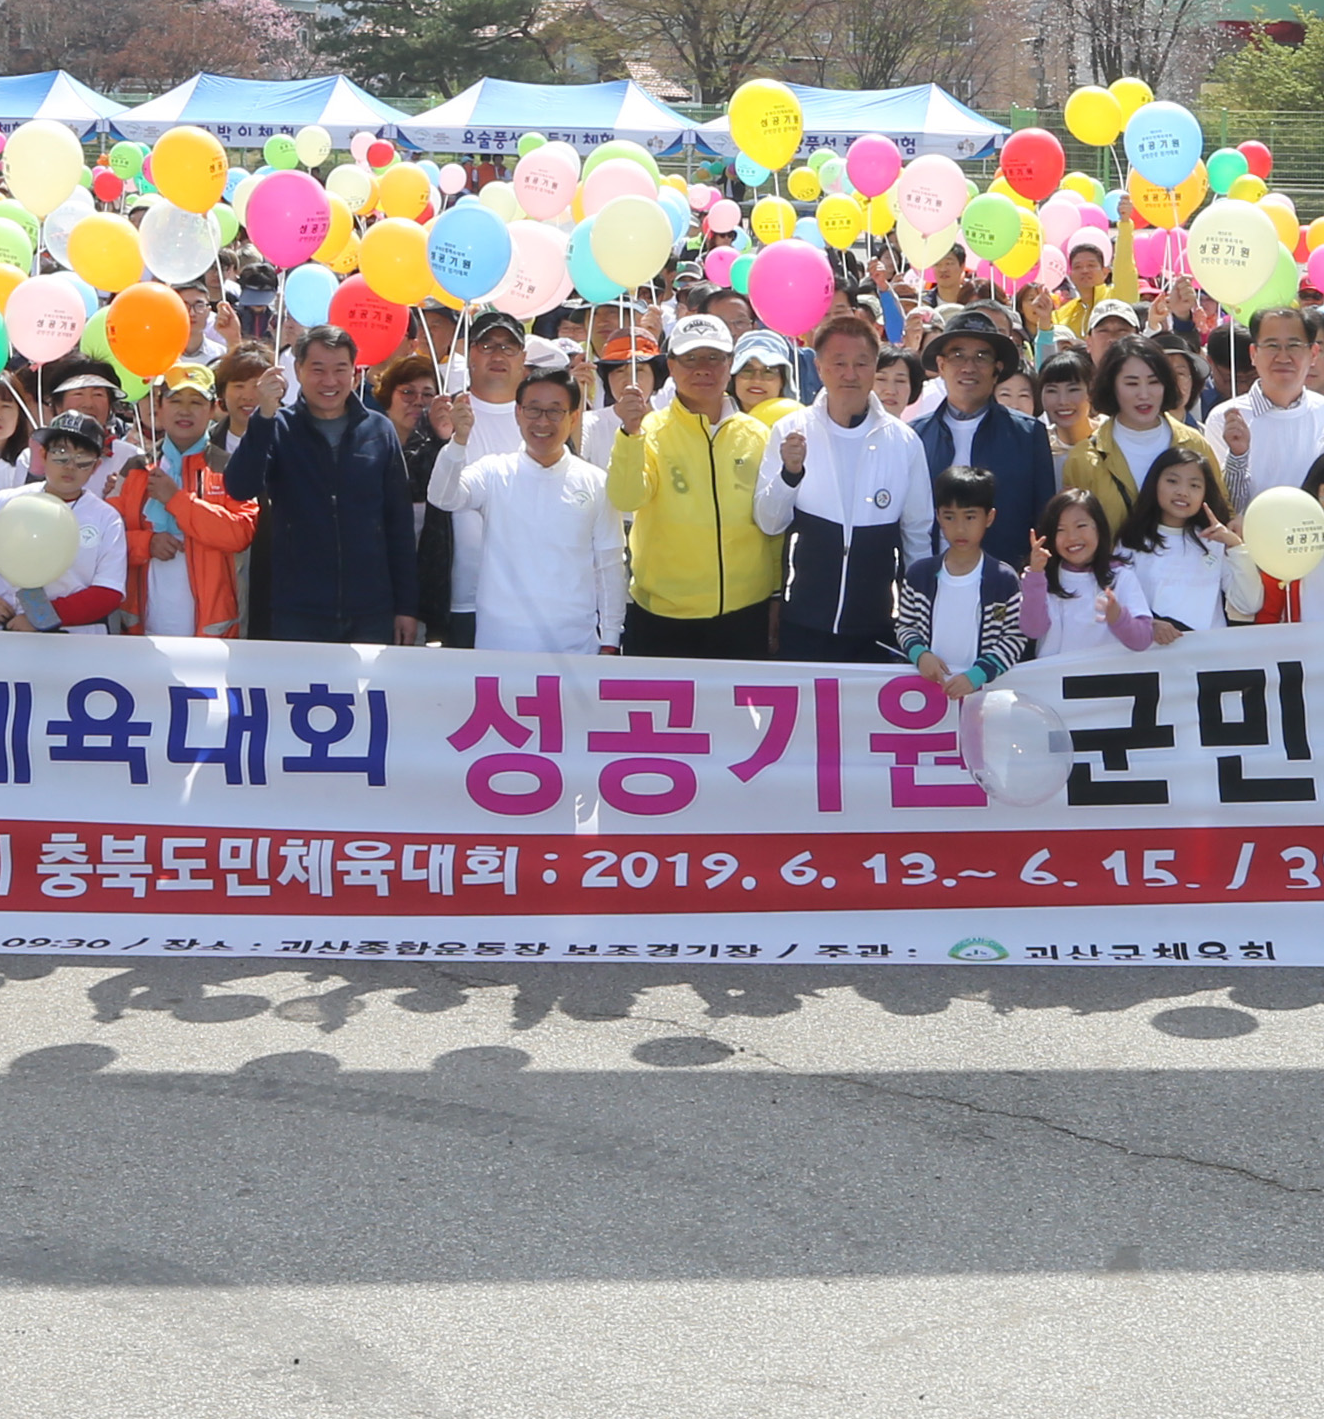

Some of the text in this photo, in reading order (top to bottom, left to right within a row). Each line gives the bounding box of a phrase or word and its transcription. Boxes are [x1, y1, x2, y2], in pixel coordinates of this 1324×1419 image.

[1199, 243, 1250, 259] 성공기원
[446, 674, 989, 818] 성공기원
[35, 832, 519, 898] 충북도민체육대회
[581, 850, 758, 890] 2019.
[779, 849, 837, 889] 6.
[1019, 847, 1078, 888] 6.
[1024, 941, 1278, 962] 괴산군체육회
